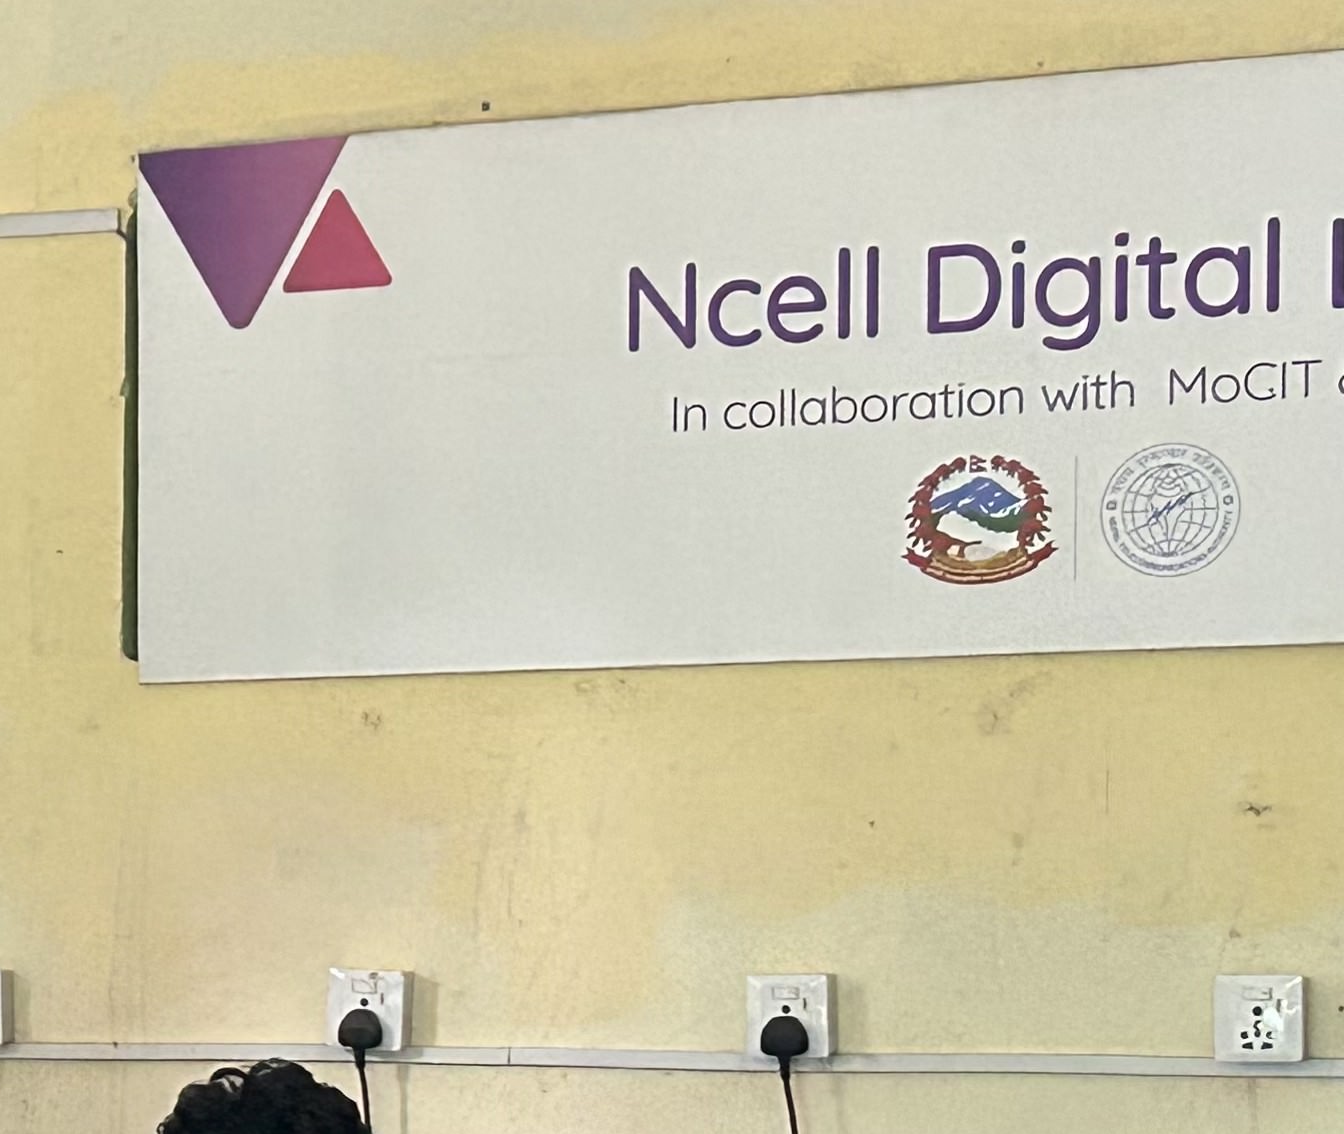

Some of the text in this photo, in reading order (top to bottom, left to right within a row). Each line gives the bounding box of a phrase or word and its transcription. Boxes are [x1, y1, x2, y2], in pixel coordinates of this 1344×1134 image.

[628, 245, 880, 353] Ncell
[927, 216, 1281, 351] Digital
[672, 396, 707, 433] In
[723, 383, 1024, 431] collaboration
[1041, 370, 1136, 412] with
[1168, 360, 1323, 405] MoCIT
